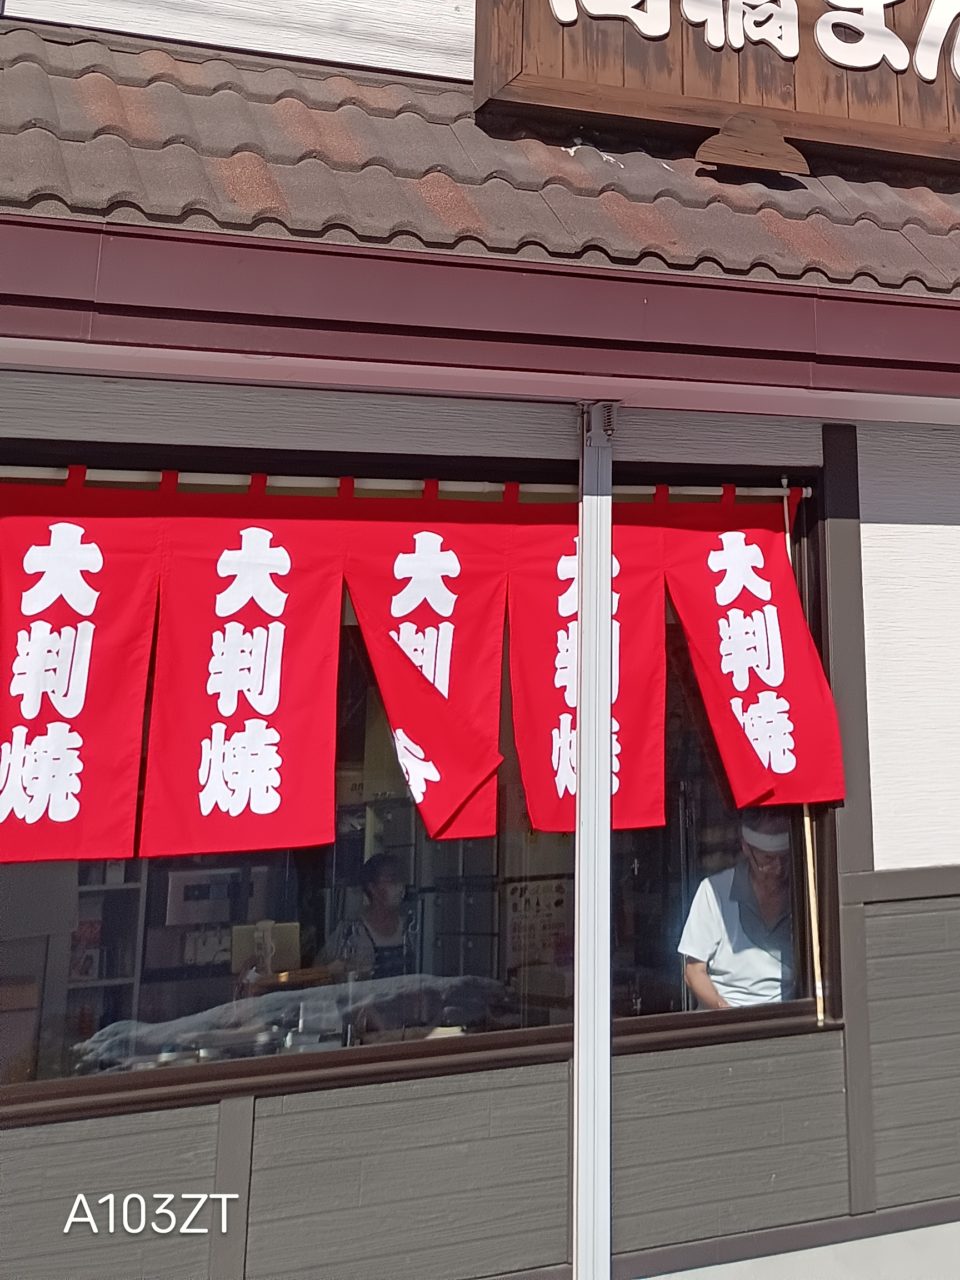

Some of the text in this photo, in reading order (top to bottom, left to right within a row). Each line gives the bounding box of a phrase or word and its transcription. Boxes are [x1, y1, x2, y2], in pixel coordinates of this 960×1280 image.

[0, 522, 104, 825] 大判焼
[198, 527, 292, 818] 大判焼
[707, 531, 798, 774] 大判焼
